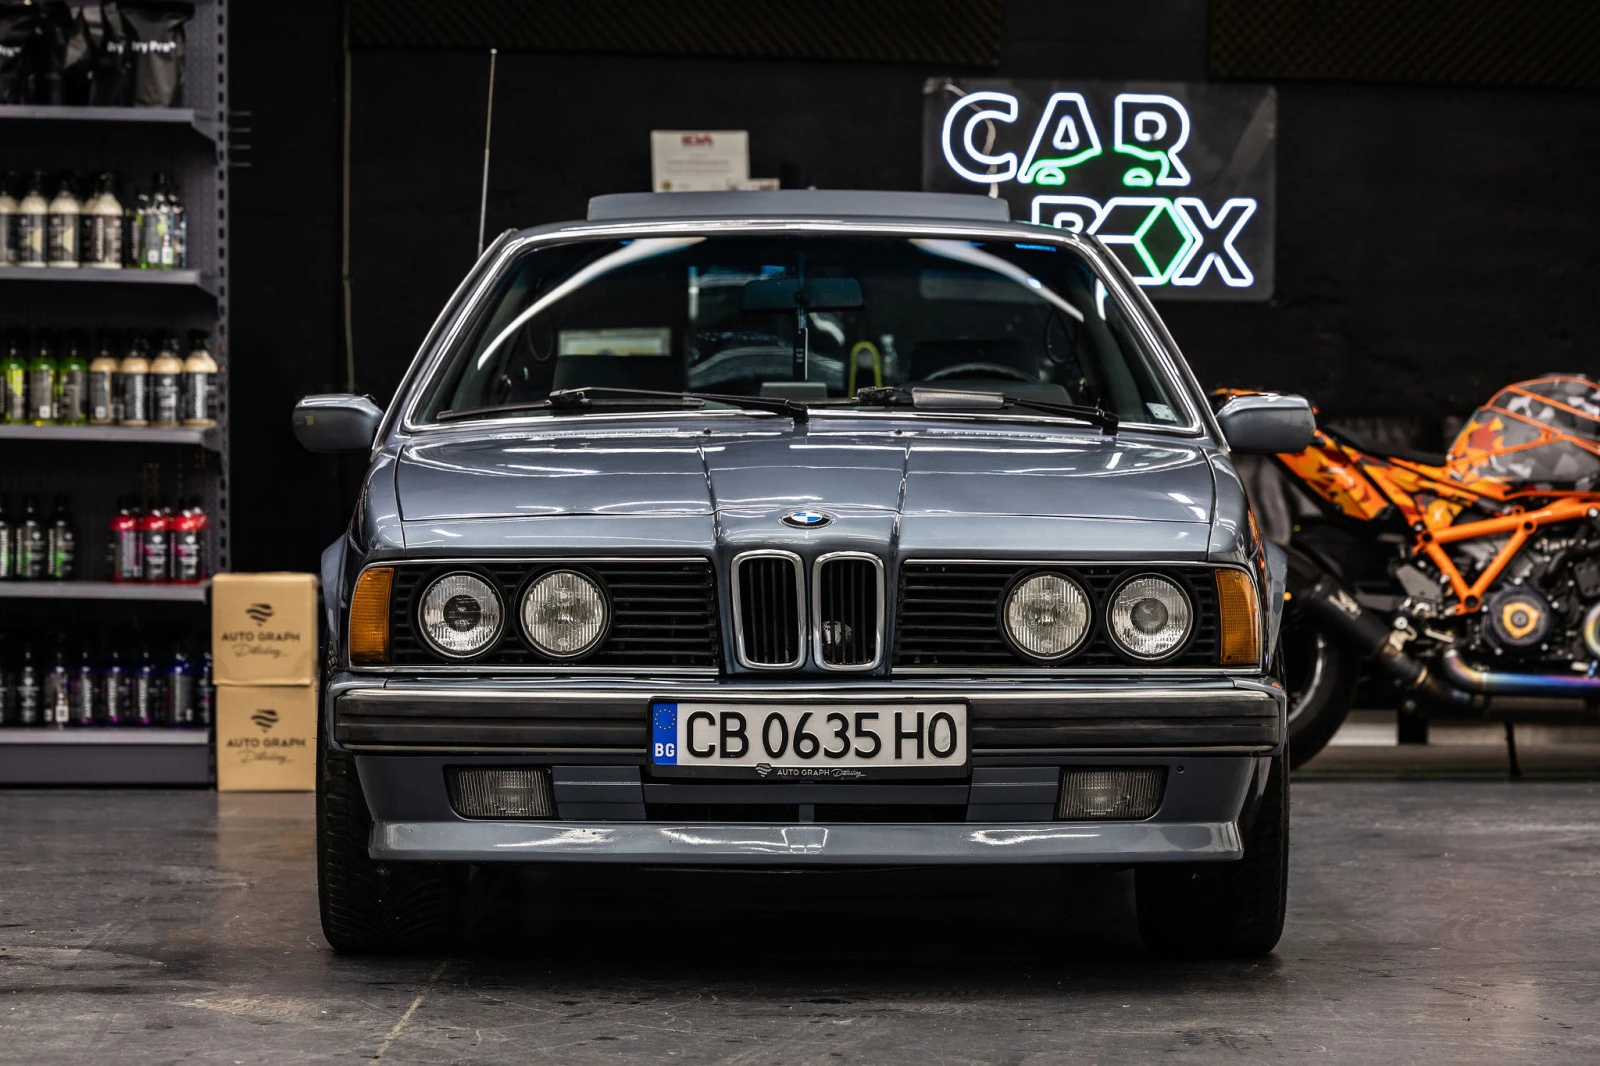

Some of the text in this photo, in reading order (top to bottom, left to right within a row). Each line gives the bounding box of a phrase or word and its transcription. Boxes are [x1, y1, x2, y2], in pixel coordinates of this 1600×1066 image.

[942, 91, 1191, 186] CAR
[221, 631, 300, 642] AUTO GRAPH
[686, 710, 750, 759] CB
[761, 711, 882, 759] 0635
[226, 737, 306, 748] AUTO GRAPH
[654, 742, 676, 758] BG
[776, 768, 800, 776] AUTO
[801, 768, 830, 776] GRAPH
